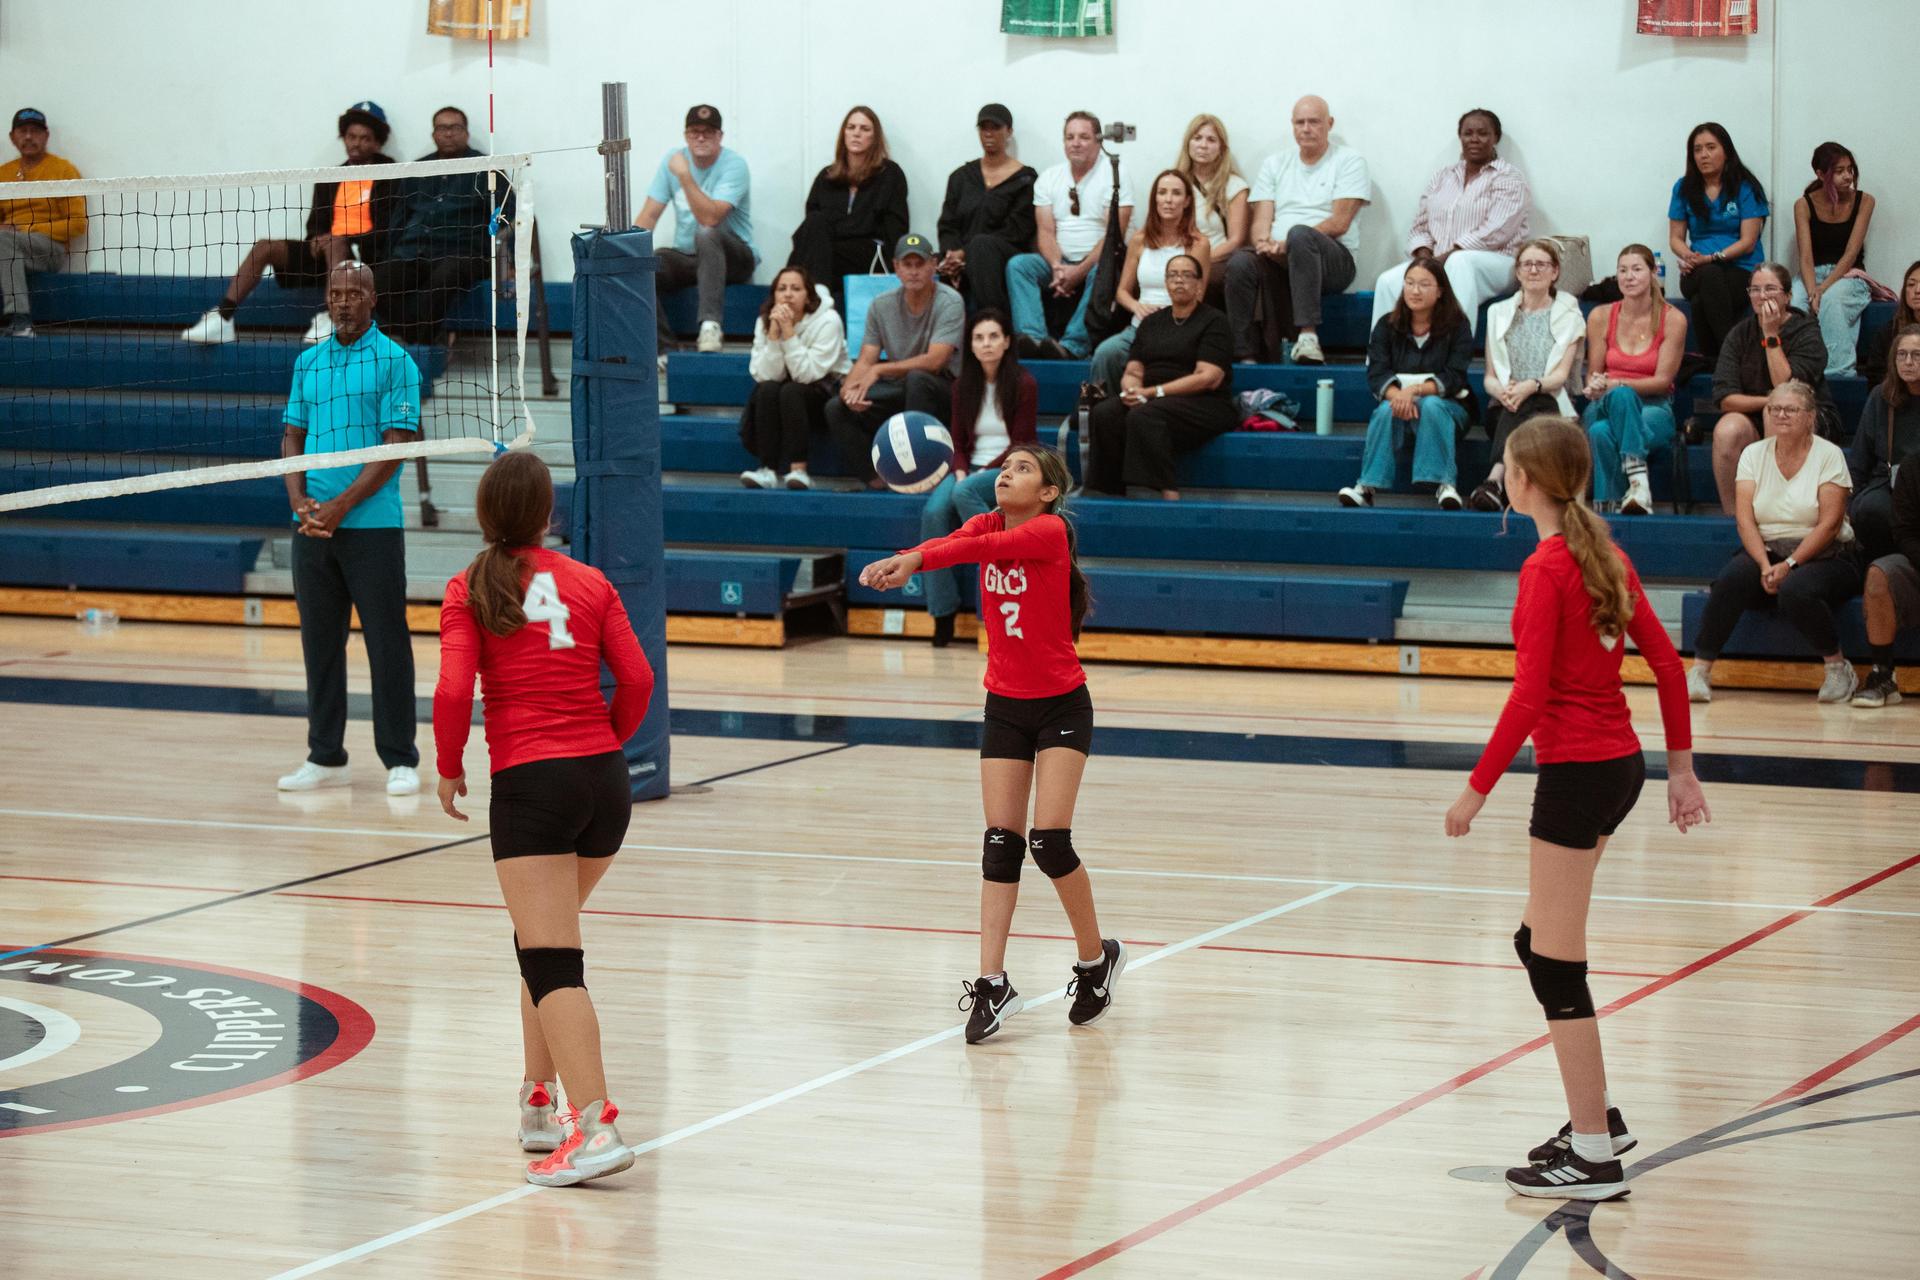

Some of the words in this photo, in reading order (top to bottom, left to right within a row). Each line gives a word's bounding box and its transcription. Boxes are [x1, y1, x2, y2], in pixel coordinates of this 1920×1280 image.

[522, 572, 576, 650] 4
[999, 601, 1024, 639] 2
[162, 988, 285, 1072] CLIPPERS
